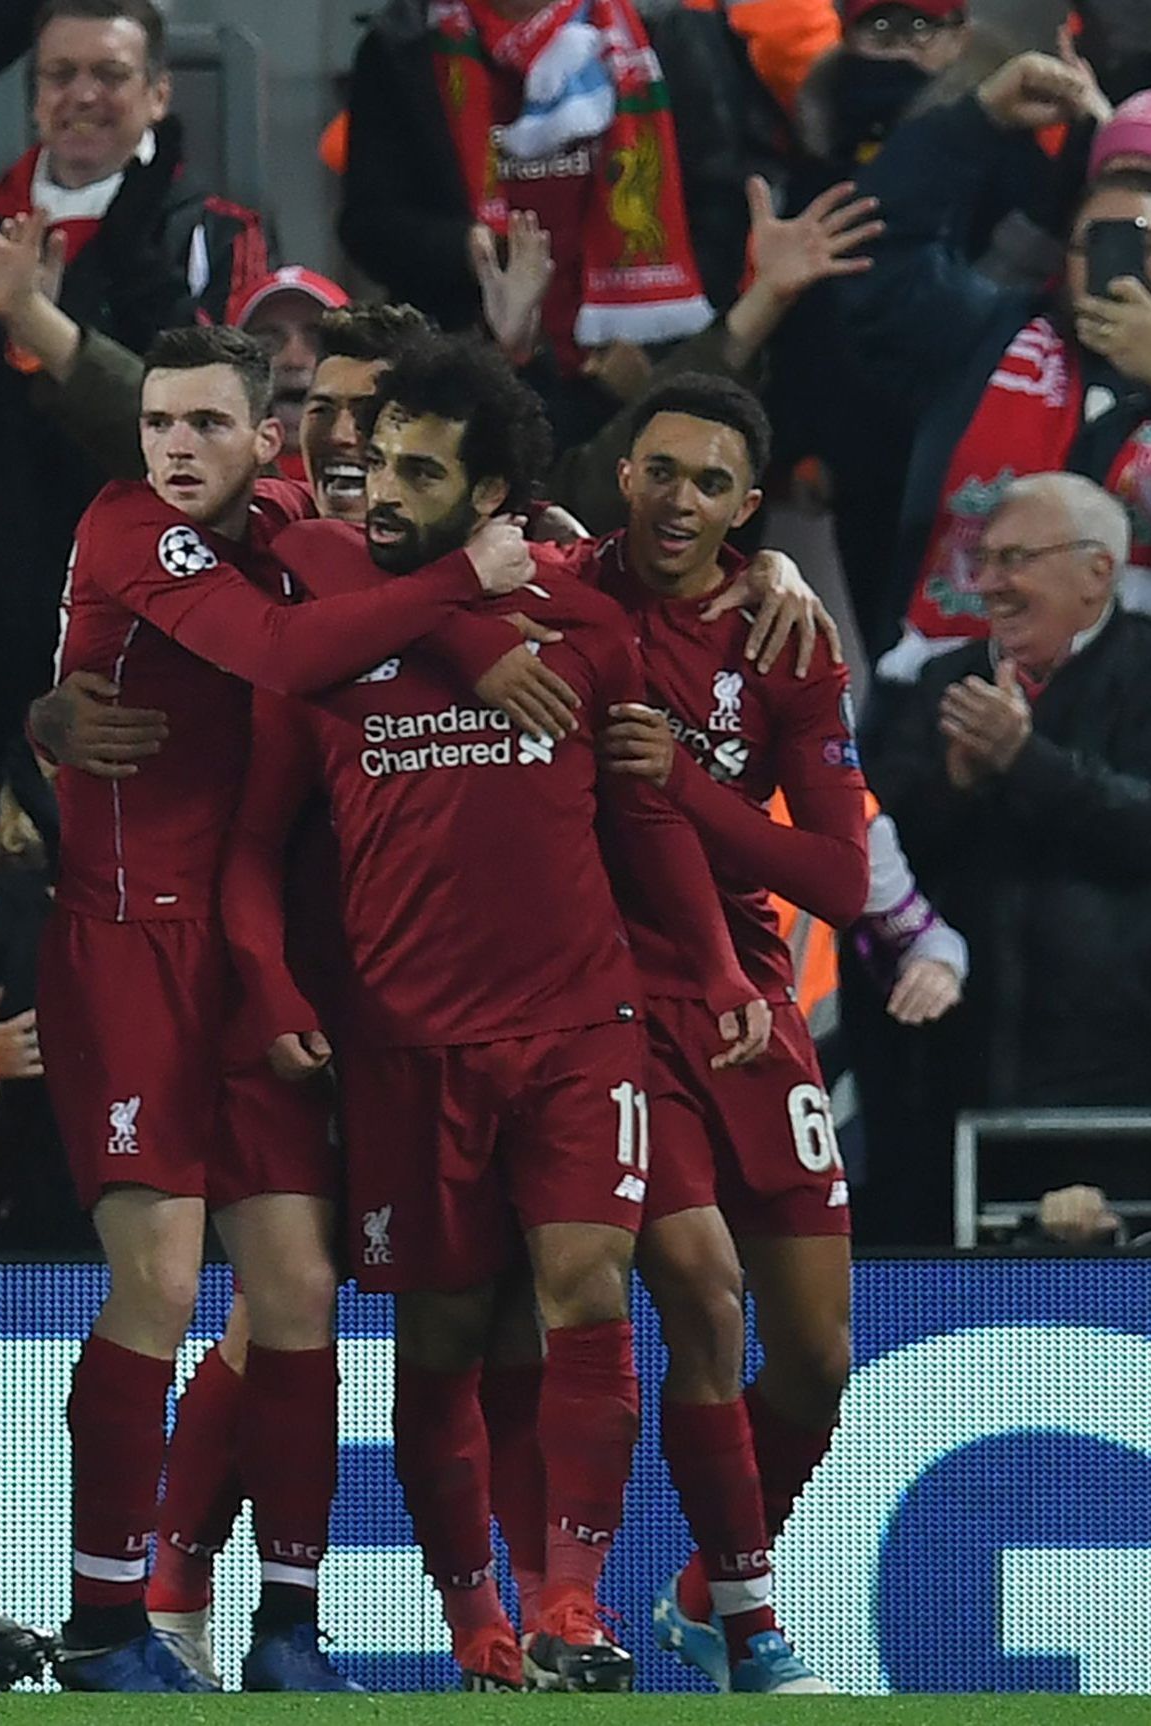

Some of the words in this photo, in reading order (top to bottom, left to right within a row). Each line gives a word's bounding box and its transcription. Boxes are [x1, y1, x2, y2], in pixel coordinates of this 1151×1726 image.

[363, 704, 510, 743] Standard
[360, 736, 511, 777] Chartered
[610, 1081, 649, 1172] 11
[788, 1083, 844, 1173] 6
[126, 1531, 158, 1552] LF
[272, 1540, 321, 1560] LFC
[720, 1549, 764, 1573] LFC
